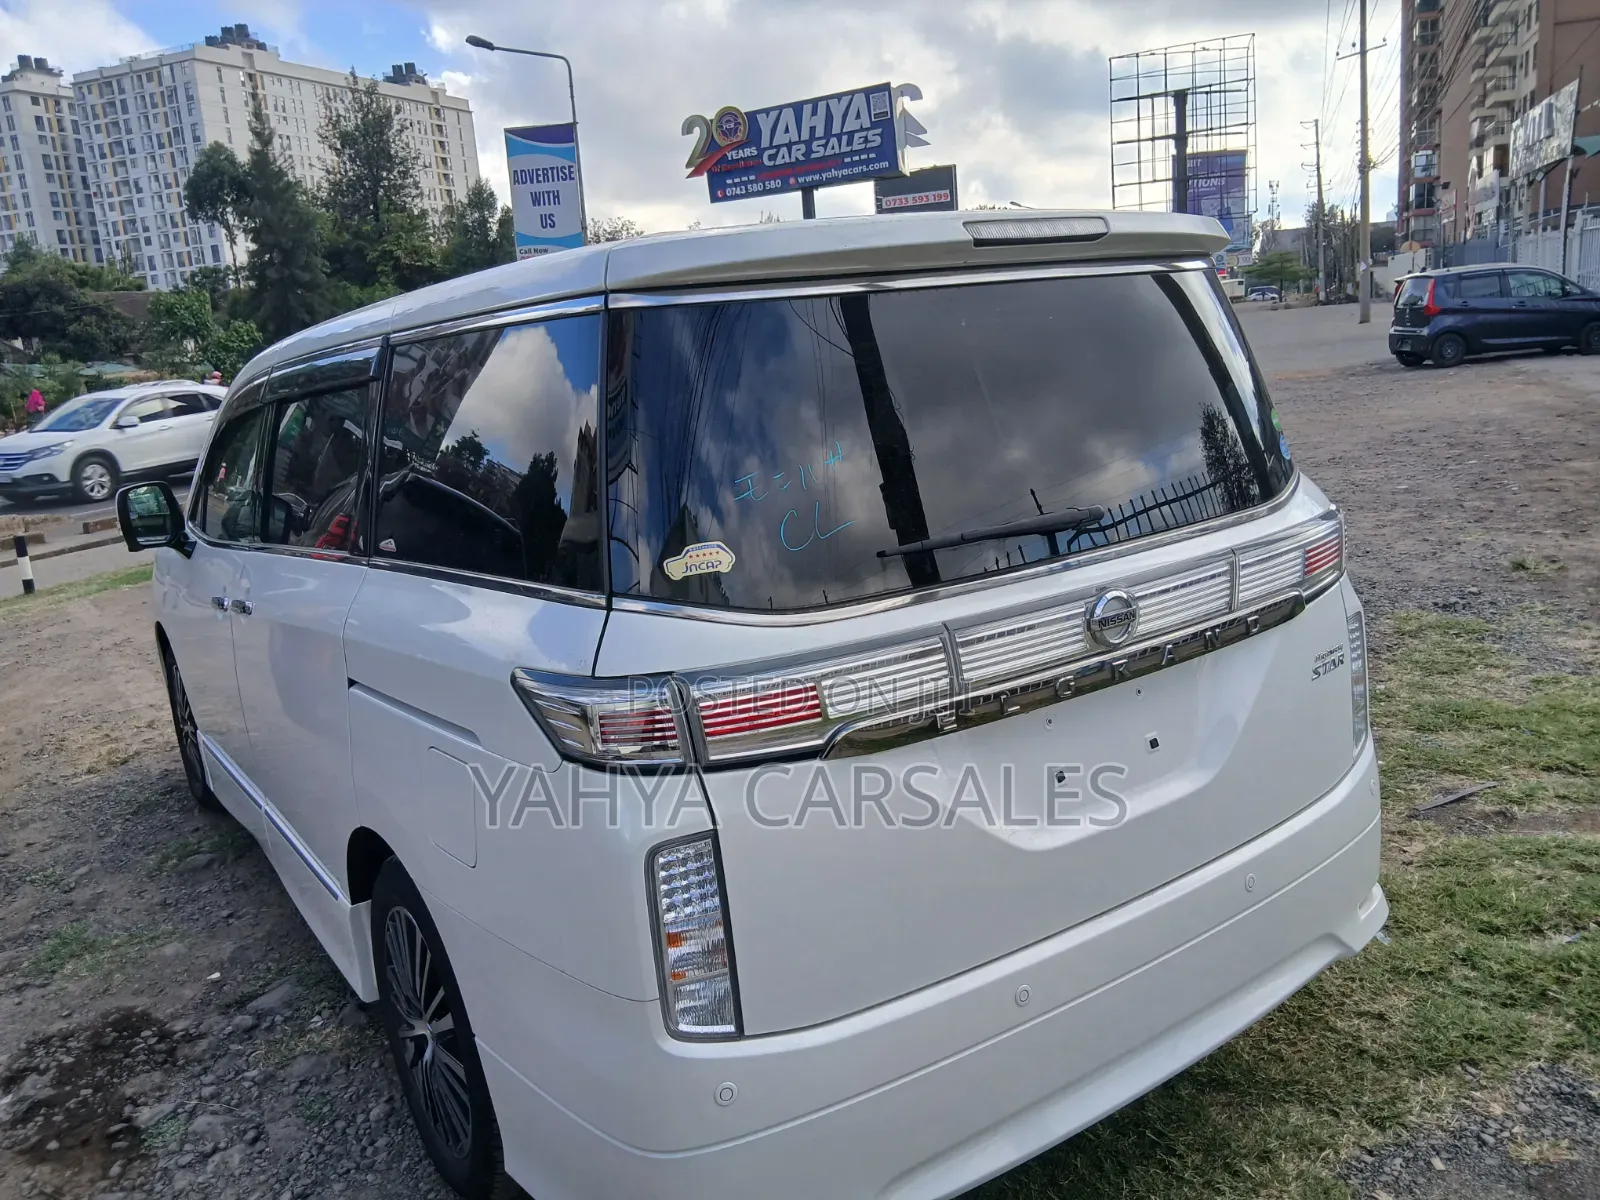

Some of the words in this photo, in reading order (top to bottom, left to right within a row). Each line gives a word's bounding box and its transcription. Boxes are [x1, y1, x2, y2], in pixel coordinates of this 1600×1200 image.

[756, 92, 871, 148] YAHYA
[726, 146, 758, 160] YEARS
[762, 143, 806, 166] CAR
[810, 128, 883, 159] SALES
[512, 165, 576, 186] ADVERTISE
[797, 160, 889, 184] www.yahyacars.com
[726, 185, 746, 196] 0743
[747, 182, 764, 193] 580
[765, 179, 782, 190] 580
[530, 189, 561, 207] WITH
[911, 194, 930, 204] 593
[932, 192, 949, 202] 199
[540, 213, 556, 229] US
[1098, 609, 1136, 629] NISSAN
[1311, 651, 1345, 682] STAR
